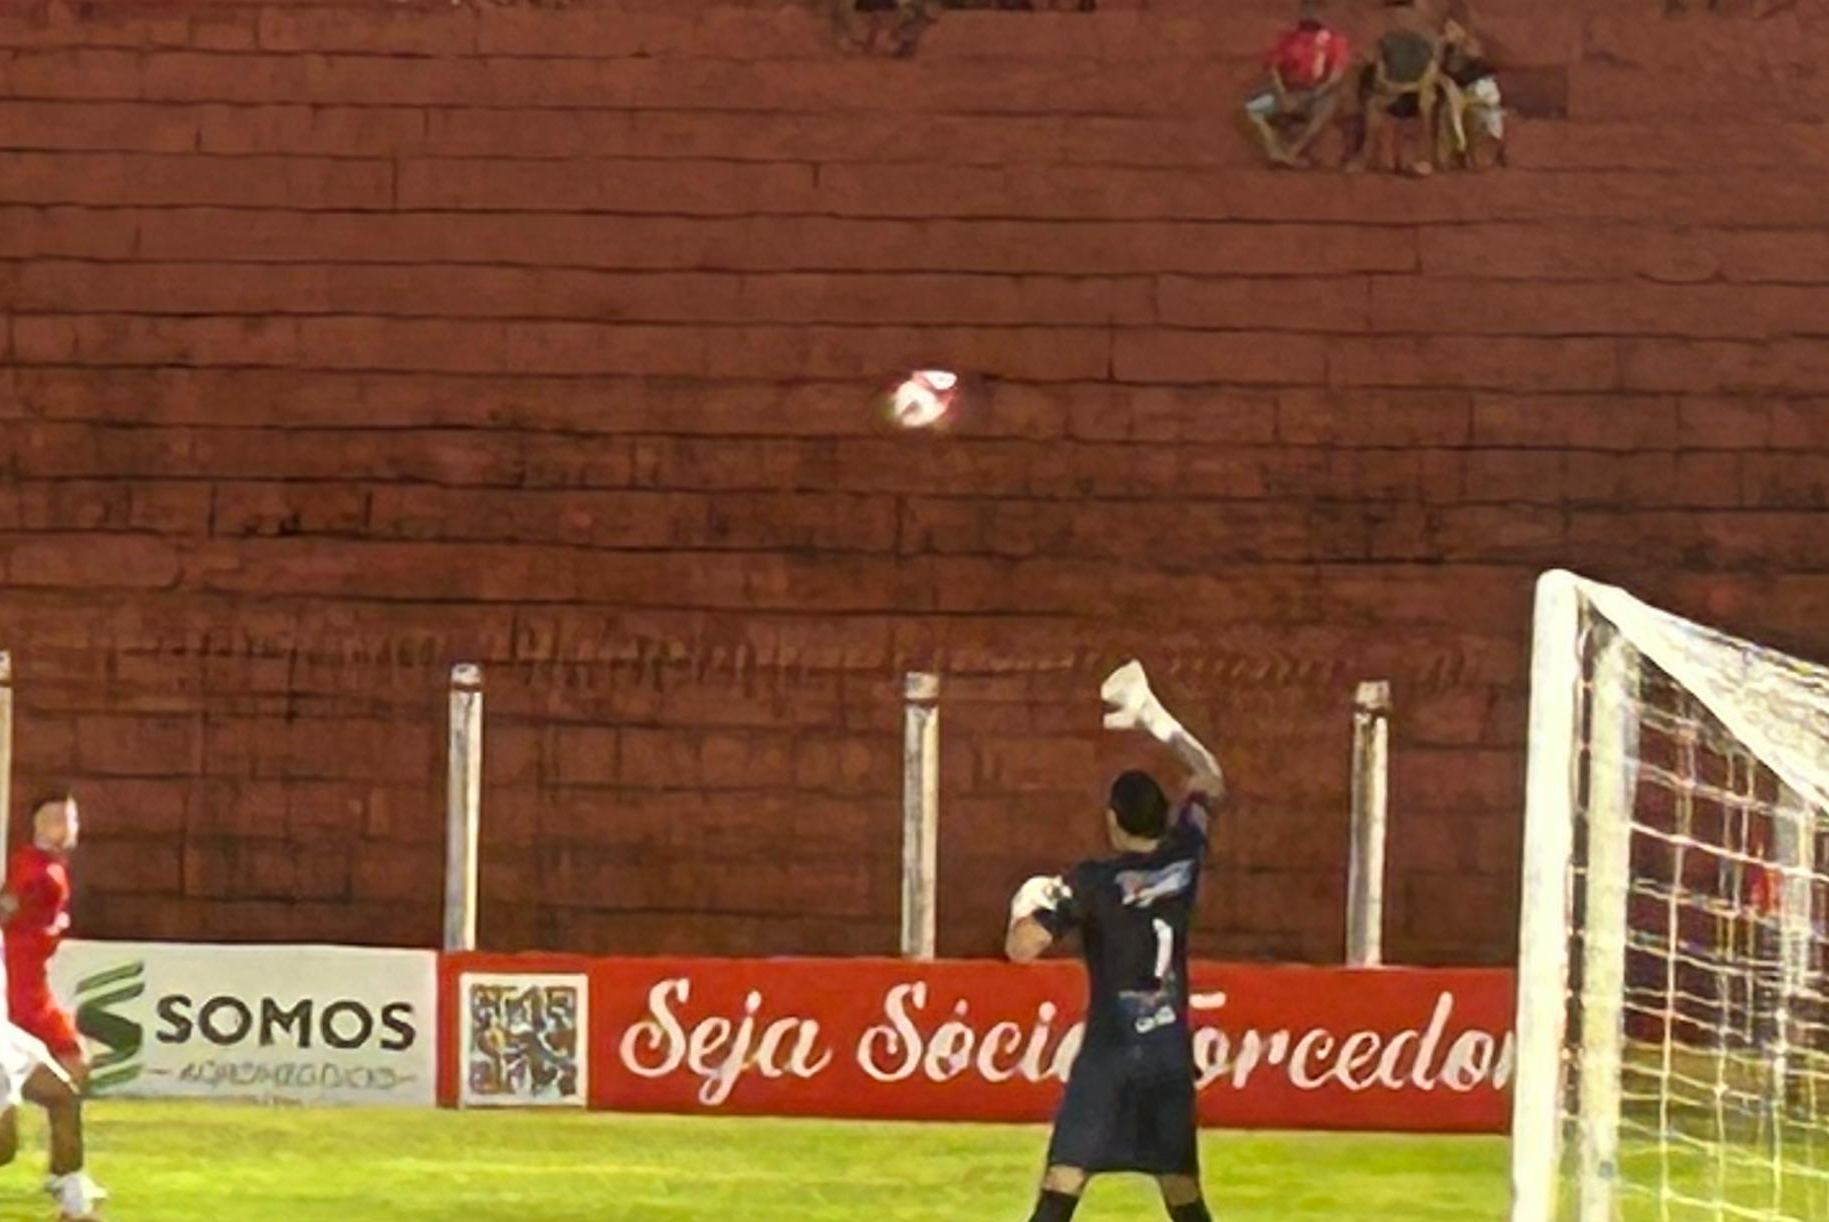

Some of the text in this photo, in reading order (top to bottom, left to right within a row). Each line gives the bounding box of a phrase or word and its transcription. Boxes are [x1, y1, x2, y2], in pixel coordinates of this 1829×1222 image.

[1152, 918, 1173, 978] 1
[155, 995, 417, 1051] SOMOS
[619, 978, 833, 1106] Seja
[1189, 991, 1516, 1091] orcedo
